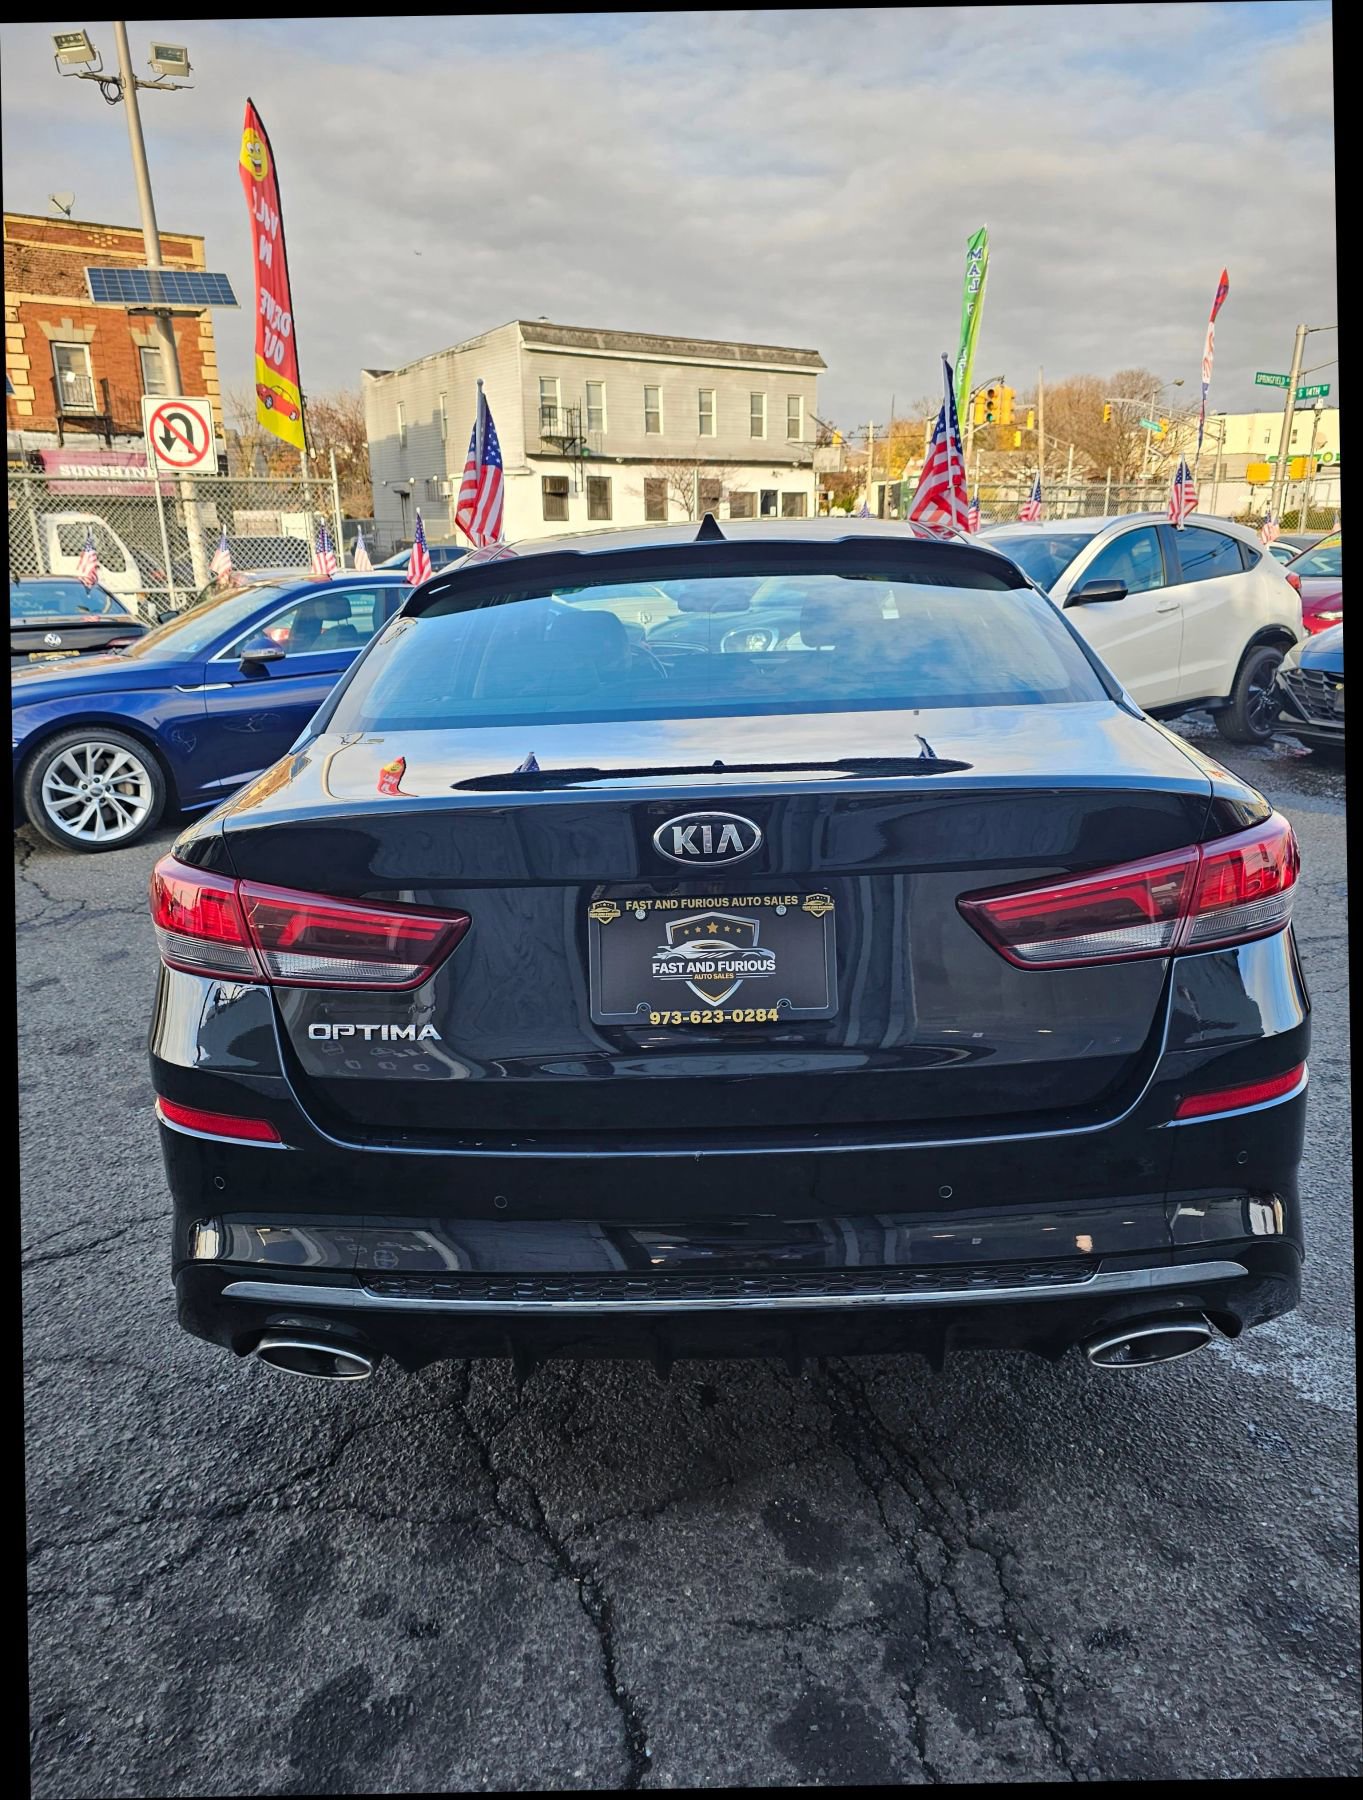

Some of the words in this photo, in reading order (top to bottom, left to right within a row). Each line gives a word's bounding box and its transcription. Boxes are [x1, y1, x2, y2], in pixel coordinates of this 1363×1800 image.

[1256, 374, 1286, 385] SPRINGFIELD
[1298, 388, 1304, 398] S
[1305, 386, 1321, 396] 14TH
[59, 464, 152, 478] SUNSHIN
[671, 823, 745, 855] KIA
[625, 900, 653, 911] FAST
[654, 899, 679, 910] AND
[680, 897, 729, 909] FURIOUS
[731, 896, 762, 907] AUTO
[763, 895, 799, 906] SALES
[652, 962, 685, 974] FAST
[686, 961, 716, 973] AND
[717, 959, 777, 972] FURIOUS
[713, 972, 735, 980] SALES
[649, 1008, 779, 1025] 973-623-0284
[308, 1023, 443, 1041] OPTIMA
